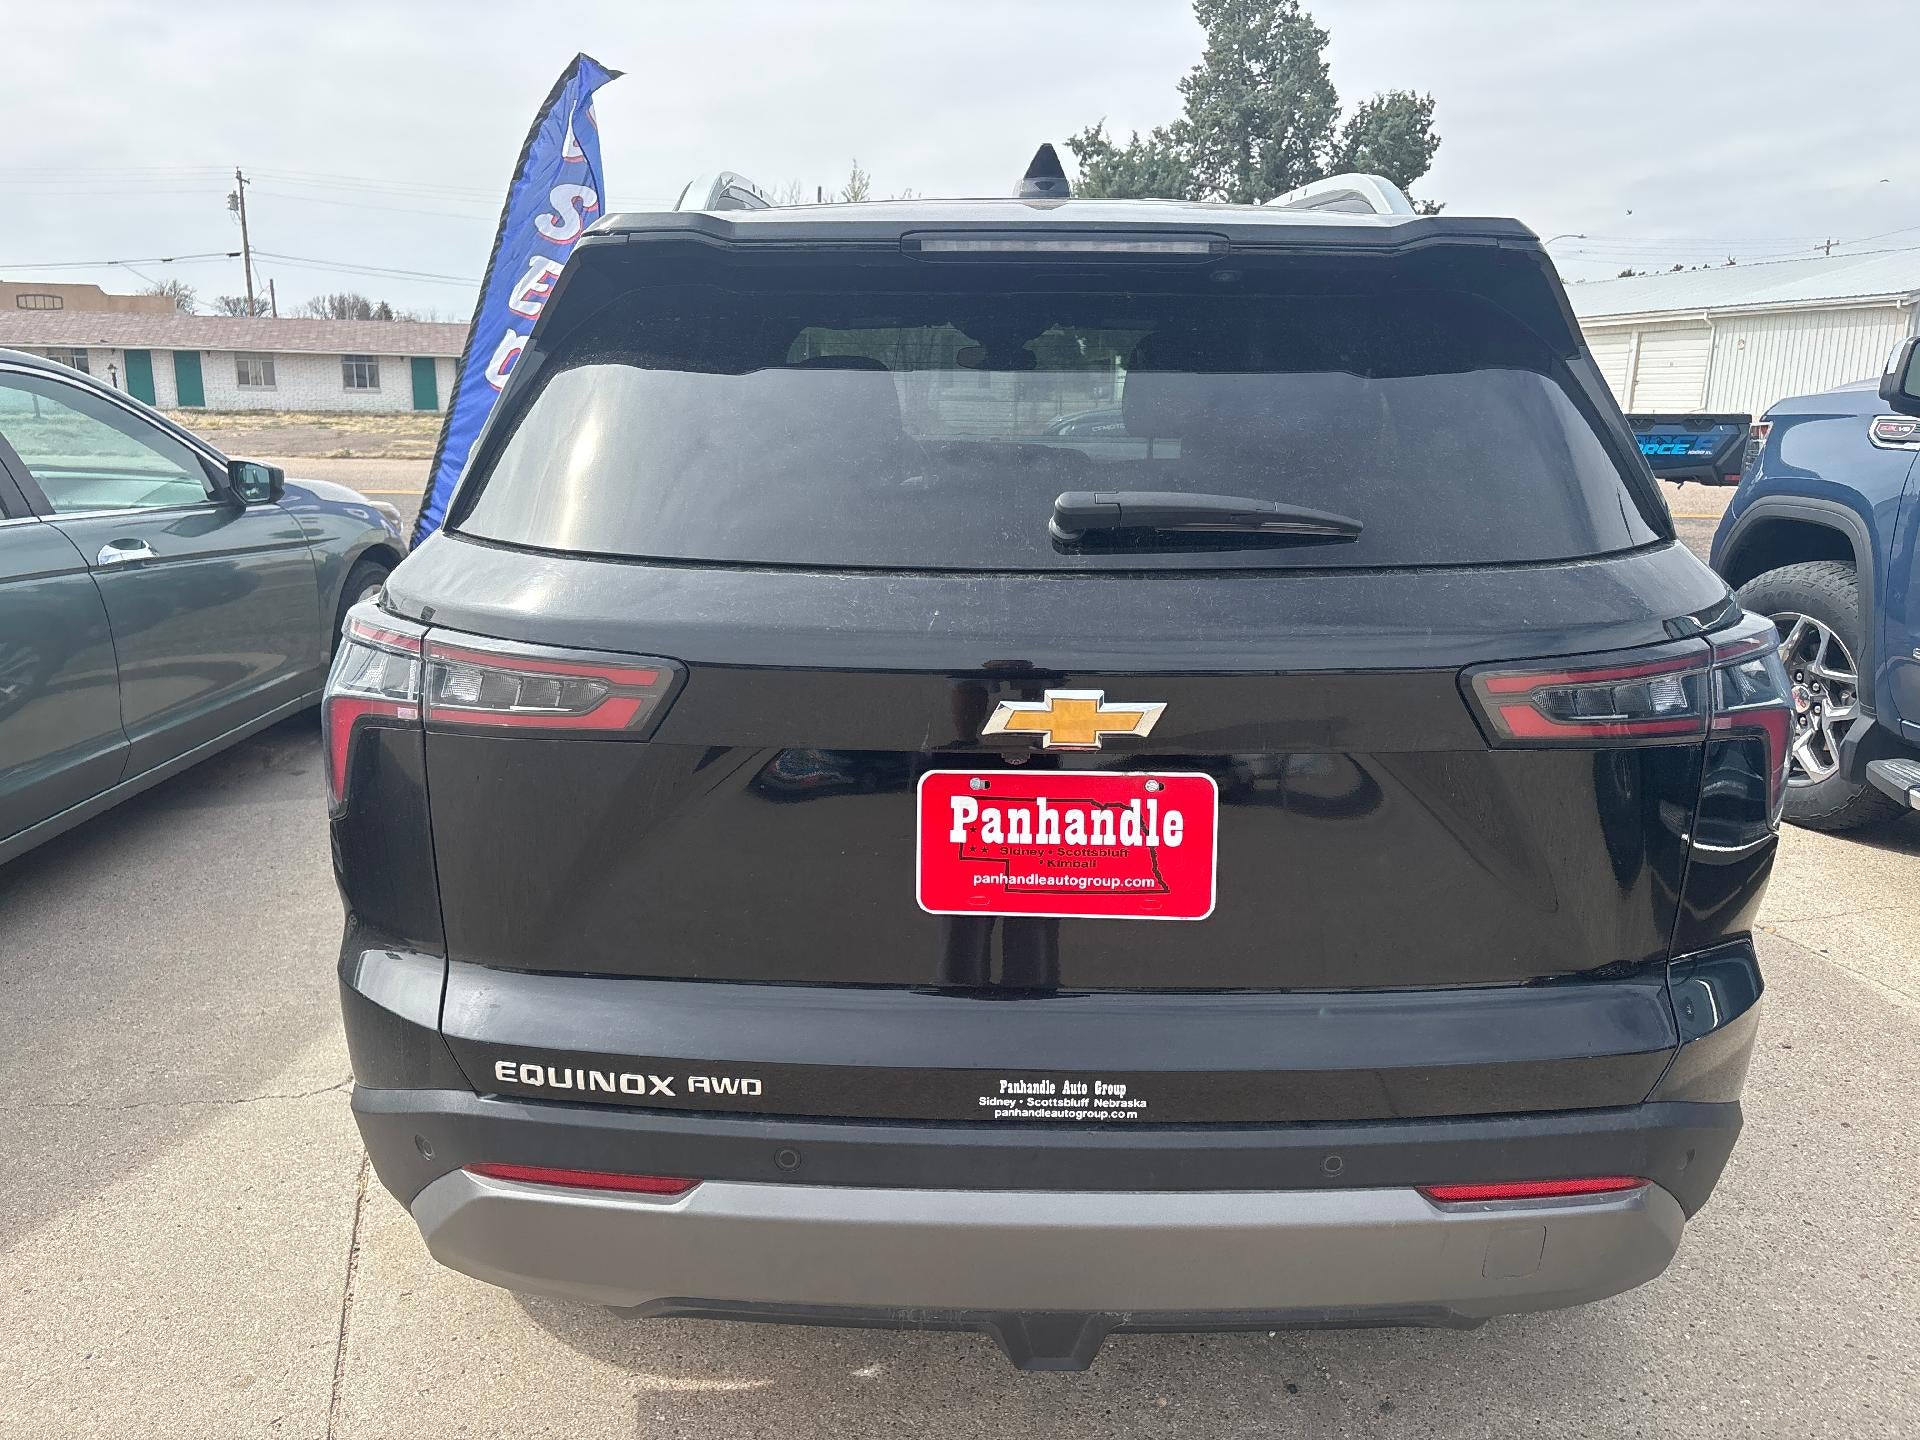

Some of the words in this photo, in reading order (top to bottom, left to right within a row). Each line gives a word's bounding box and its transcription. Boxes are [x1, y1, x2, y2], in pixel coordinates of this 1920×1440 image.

[1639, 443, 1690, 455] RCE
[949, 795, 1184, 848] Panhandle
[999, 847, 1045, 857] Sidney
[1057, 848, 1129, 858] Scottsbluff
[1047, 859, 1097, 868] Kimball
[972, 873, 1155, 890] panhandleautogroup.com
[494, 1060, 676, 1096] EQUINOX
[687, 1075, 762, 1096] AWD
[999, 1079, 1056, 1095] Panhandle
[1061, 1080, 1088, 1095] Auto
[1094, 1080, 1127, 1098] Group
[978, 1097, 1017, 1108] Sidney
[1026, 1097, 1090, 1108] Scottsbluff
[1093, 1099, 1147, 1108] Nebraska
[994, 1109, 1138, 1120] panhandleautogroup.com
